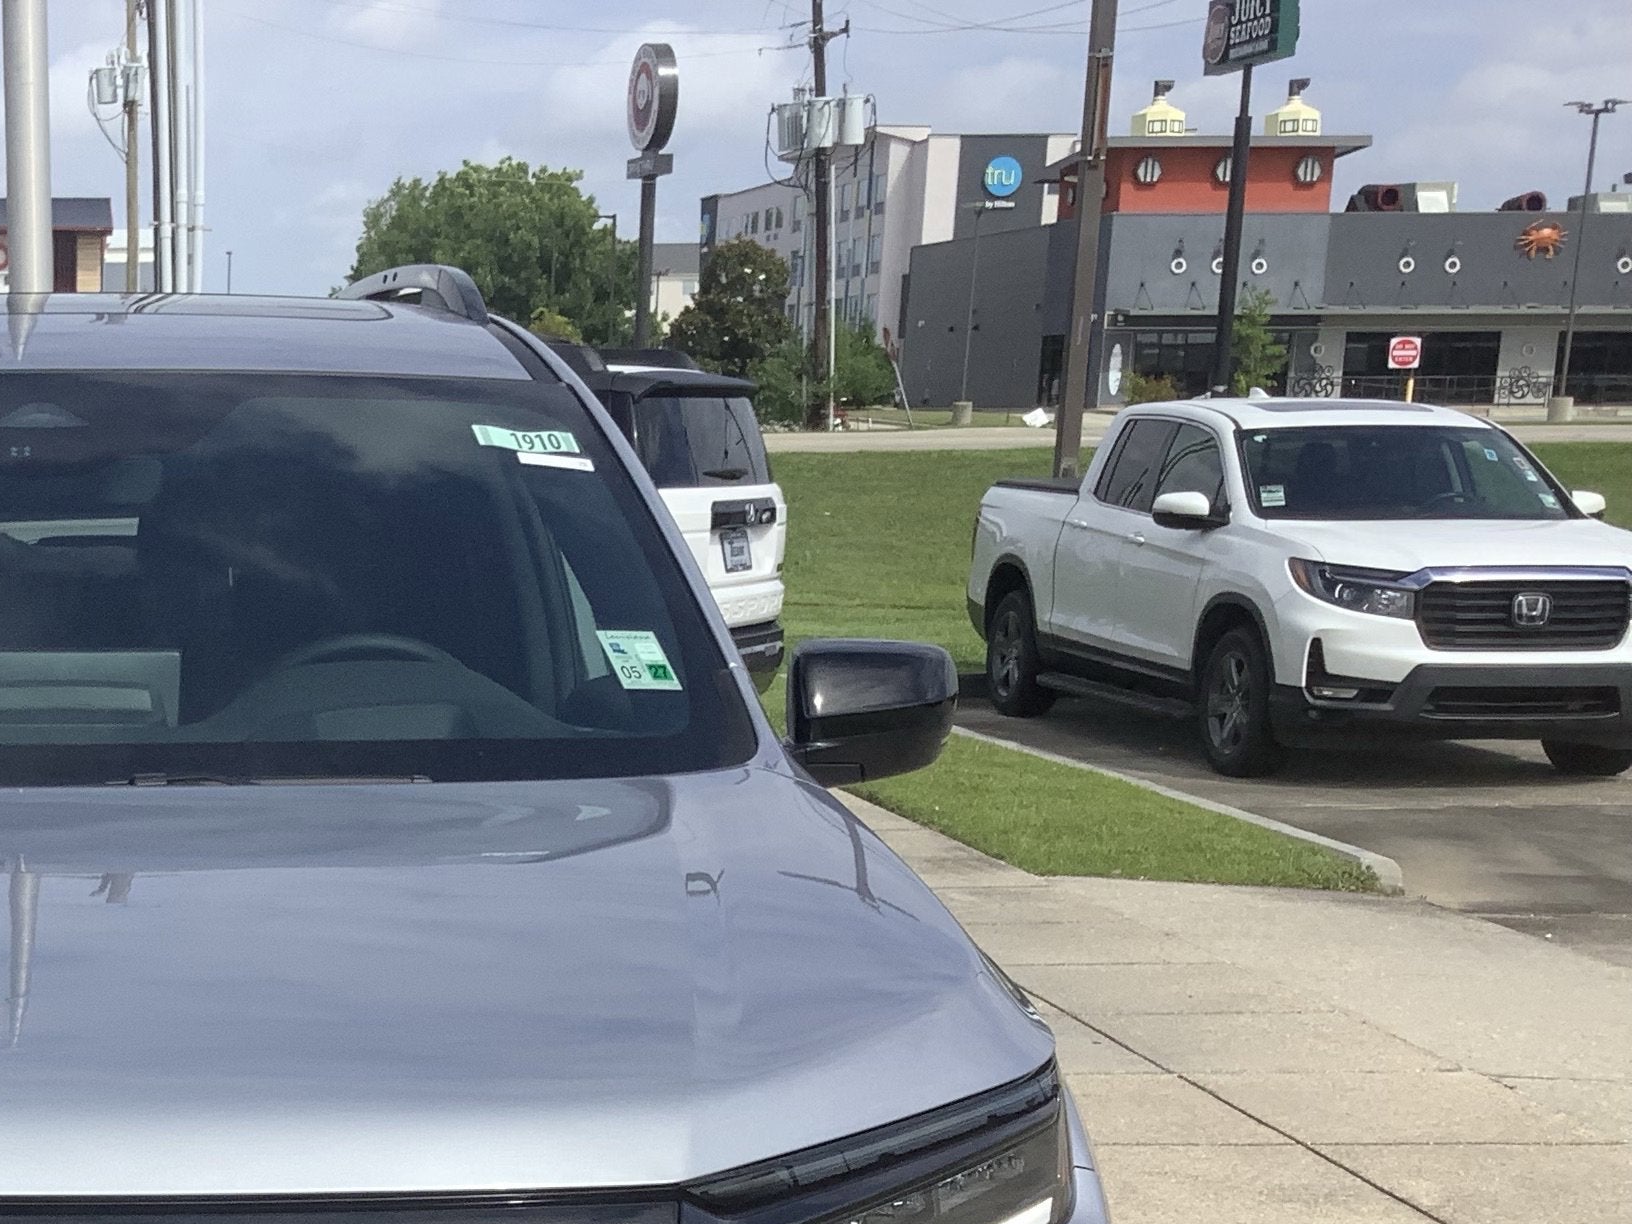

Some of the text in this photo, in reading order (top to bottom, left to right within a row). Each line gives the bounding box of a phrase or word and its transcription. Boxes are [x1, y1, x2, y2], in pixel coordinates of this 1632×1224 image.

[1229, 16, 1272, 46] SEAFOOD
[985, 166, 1015, 185] tru
[510, 432, 562, 451] 1910
[620, 664, 668, 679] 05 27
